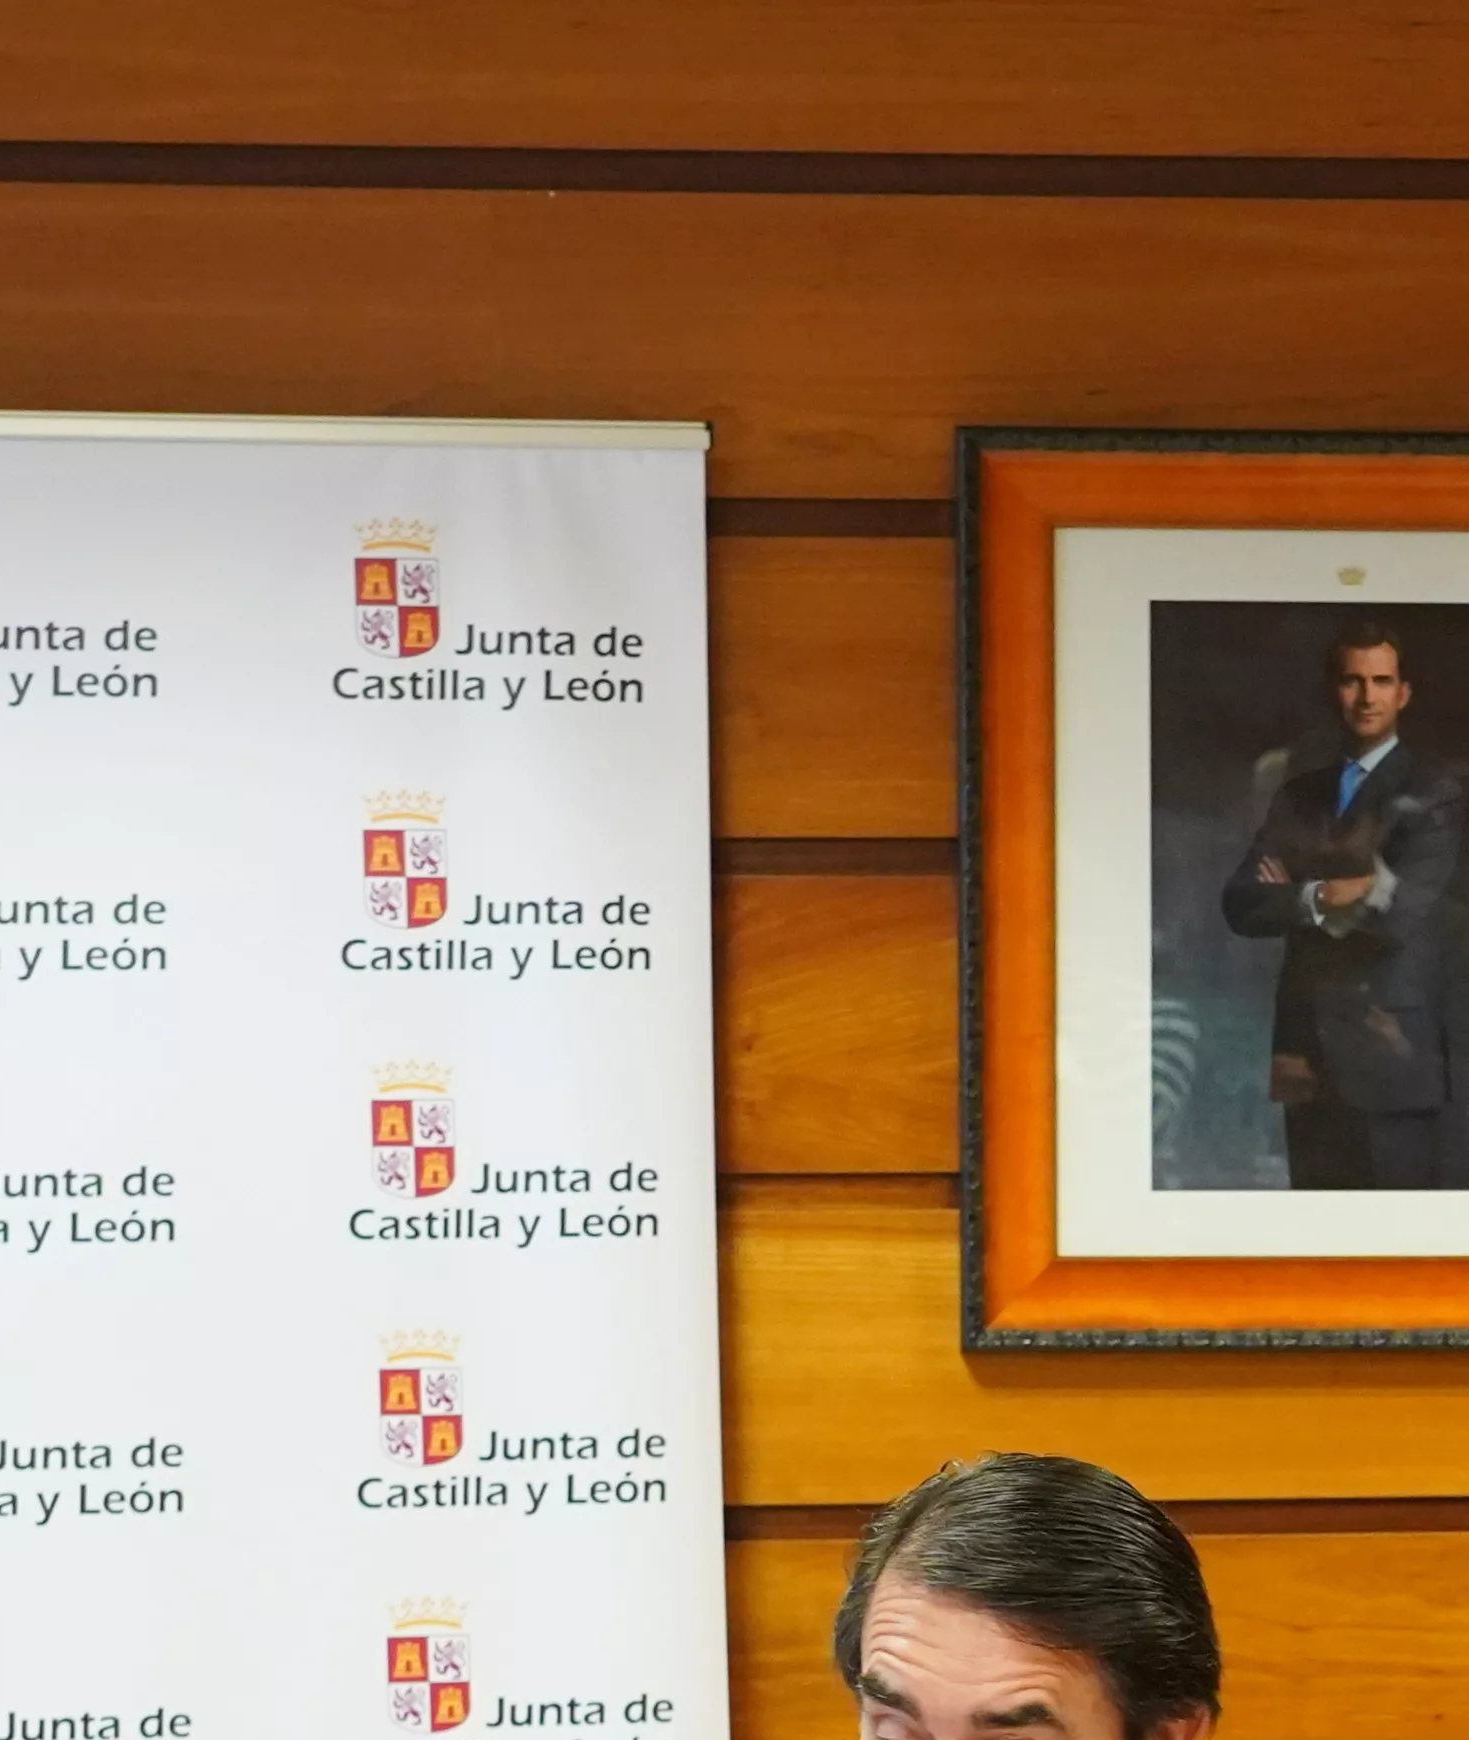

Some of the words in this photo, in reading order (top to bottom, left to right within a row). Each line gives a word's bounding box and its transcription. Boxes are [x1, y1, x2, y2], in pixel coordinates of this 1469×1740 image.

[105, 621, 156, 651] de
[456, 625, 575, 655] Junta
[593, 626, 643, 658] de
[10, 673, 32, 706] y
[54, 665, 156, 696] León
[334, 668, 484, 700] Castilla
[503, 678, 525, 710] y
[545, 670, 642, 703] León
[115, 895, 165, 923] de
[464, 896, 582, 924] Junta
[602, 895, 650, 925] de
[20, 948, 41, 980] y
[63, 940, 165, 969] León
[342, 940, 491, 970] Castilla
[511, 948, 532, 979] y
[553, 940, 650, 969] León
[123, 1167, 173, 1195] de
[472, 1164, 589, 1193] Junta
[610, 1163, 657, 1191] de
[29, 1221, 50, 1252] y
[72, 1213, 174, 1241] León
[350, 1210, 499, 1239] Castilla
[519, 1216, 540, 1248] y
[561, 1208, 657, 1236] León
[132, 1438, 182, 1467] de
[480, 1432, 596, 1460] Junta
[618, 1429, 665, 1457] de
[37, 1494, 58, 1525] y
[81, 1485, 182, 1513] León
[358, 1477, 506, 1507] Castilla
[527, 1484, 547, 1514] y
[568, 1475, 665, 1503] León
[140, 1709, 190, 1737] de
[487, 1698, 604, 1726] Junta
[625, 1694, 672, 1723] de
